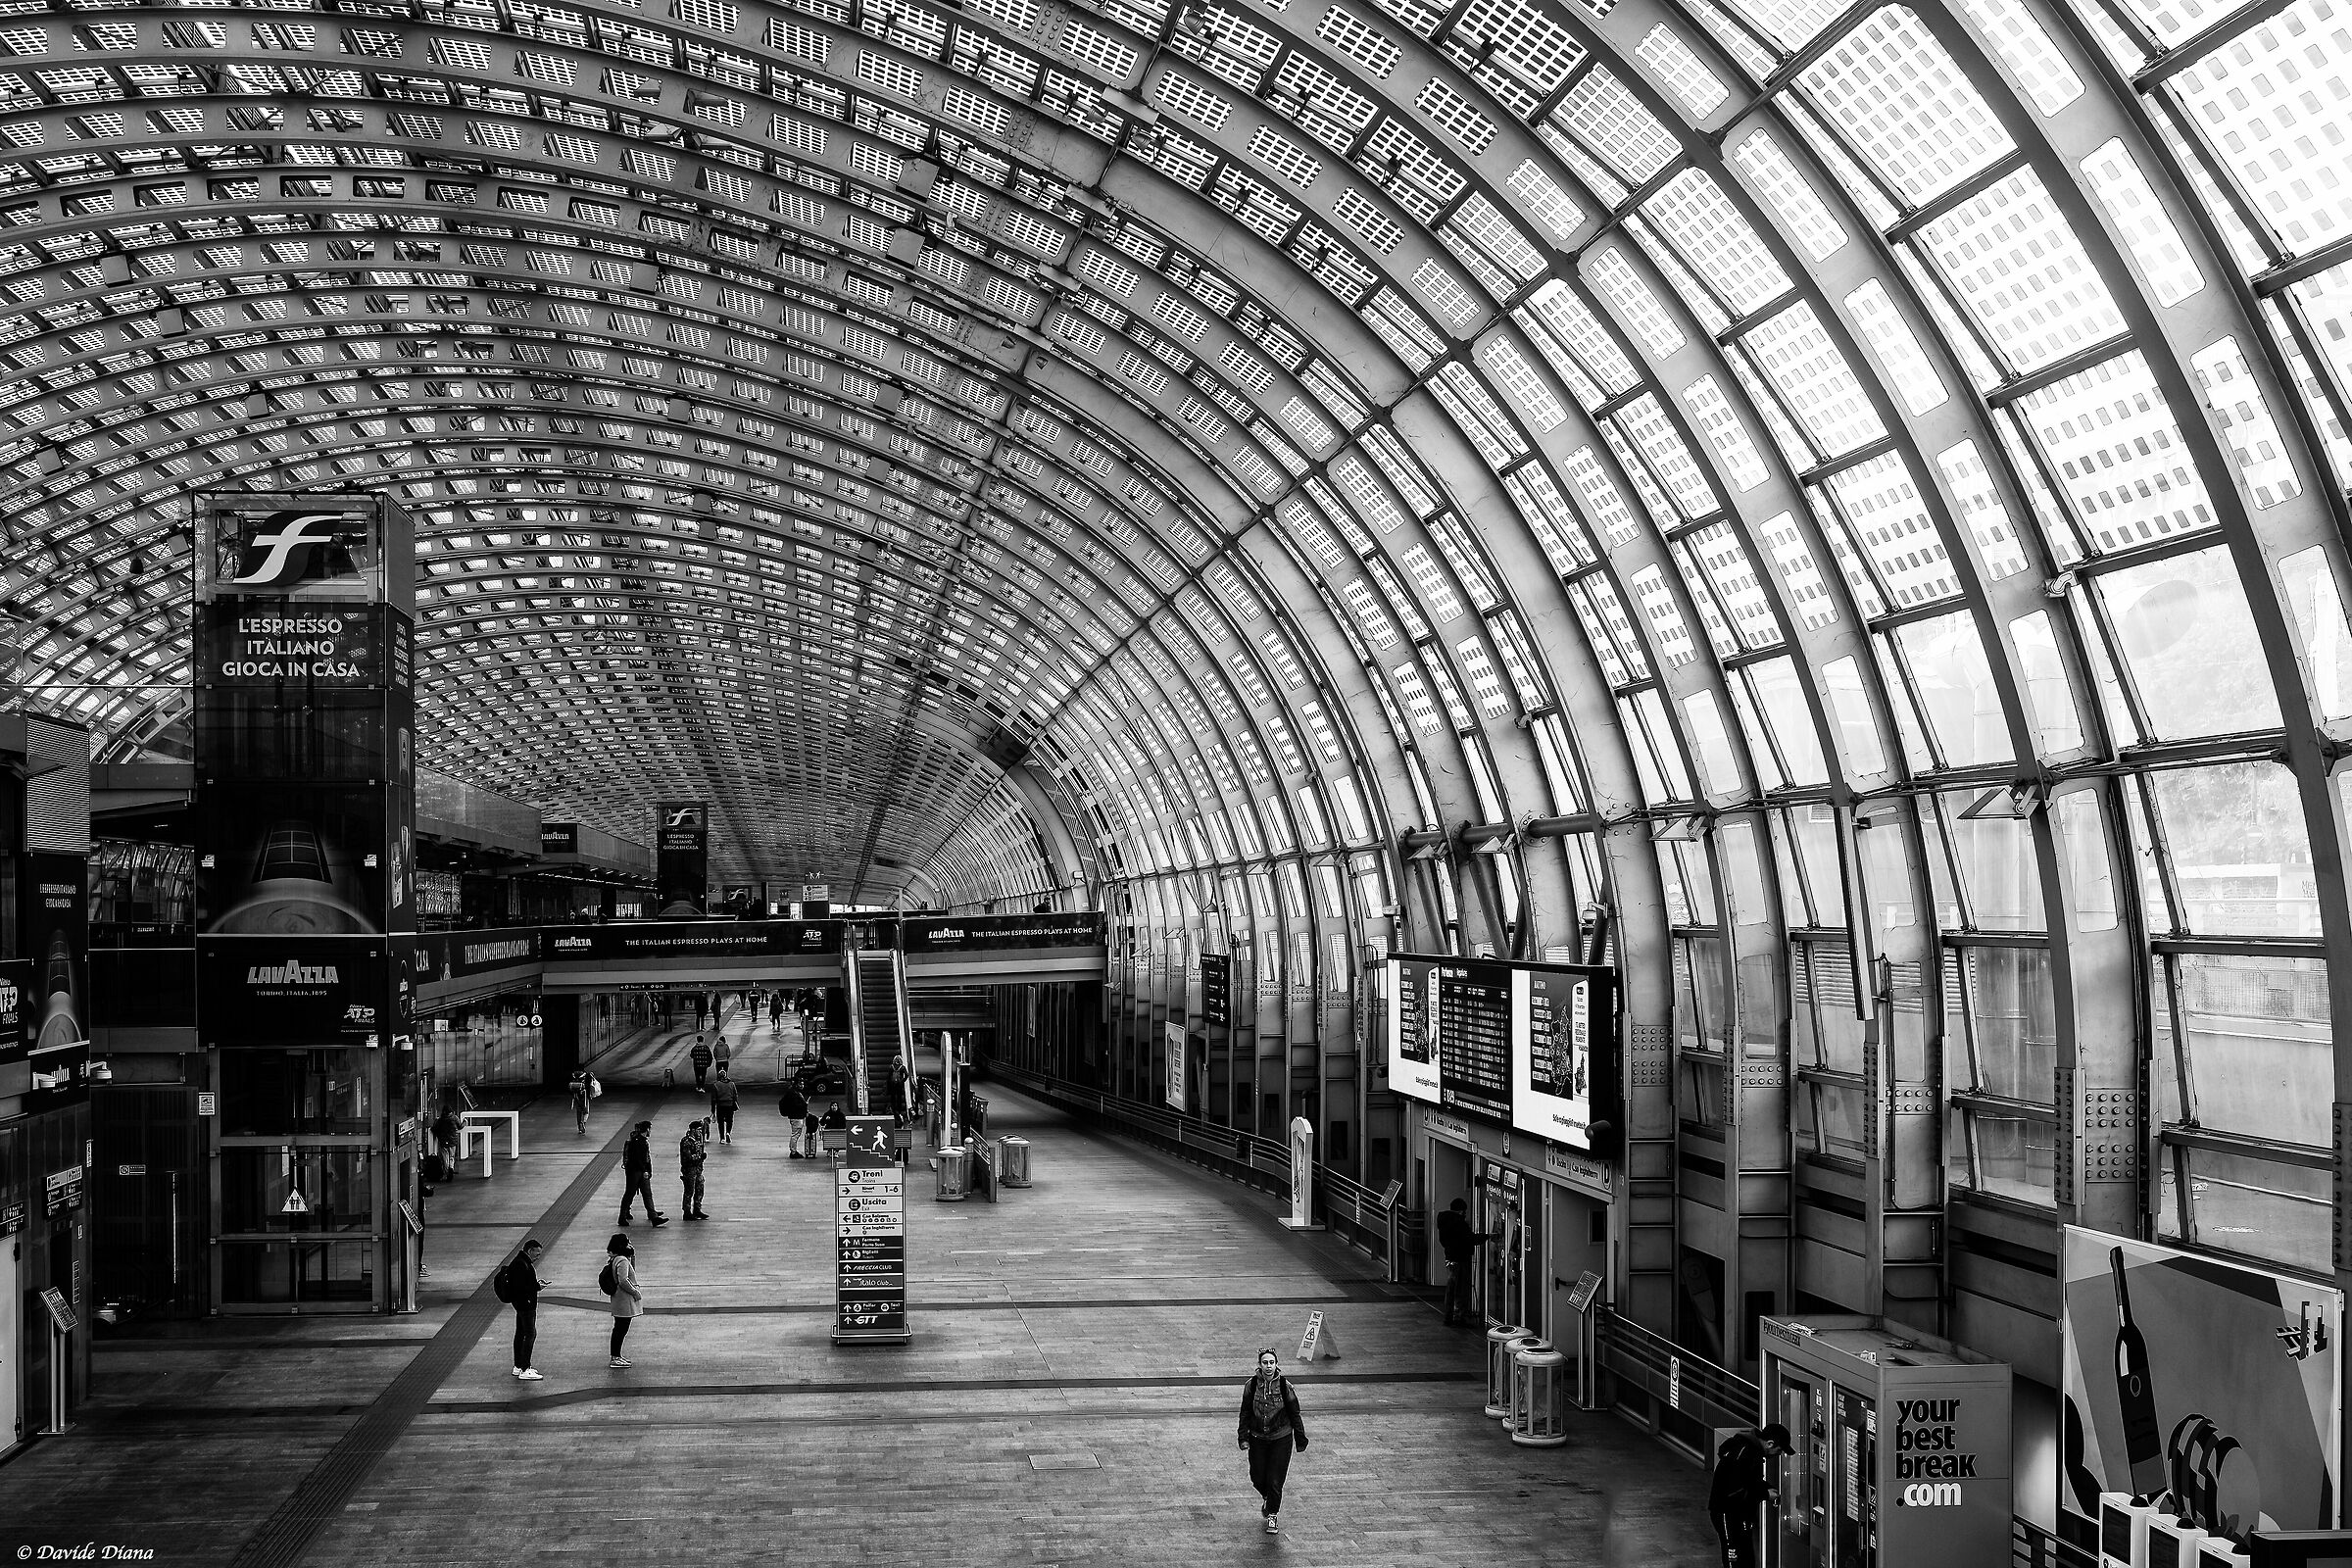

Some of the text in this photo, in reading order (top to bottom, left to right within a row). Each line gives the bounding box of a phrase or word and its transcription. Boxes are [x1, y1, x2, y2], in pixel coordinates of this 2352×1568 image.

[238, 618, 343, 633] L'ESPRESSO
[247, 640, 335, 655] ITALIANO
[221, 662, 360, 677] GIOCA IN CASA
[928, 927, 964, 938] LAVAZZA
[555, 936, 592, 948] LAVAZZA
[247, 959, 339, 984] LAVAZZA
[344, 1008, 375, 1018] ATP
[862, 1169, 883, 1178] Treni
[855, 1315, 878, 1324] GTT
[1895, 1399, 1961, 1426] your
[1895, 1424, 1956, 1451] best
[1895, 1451, 1977, 1479] break
[1895, 1483, 1962, 1507] .com
